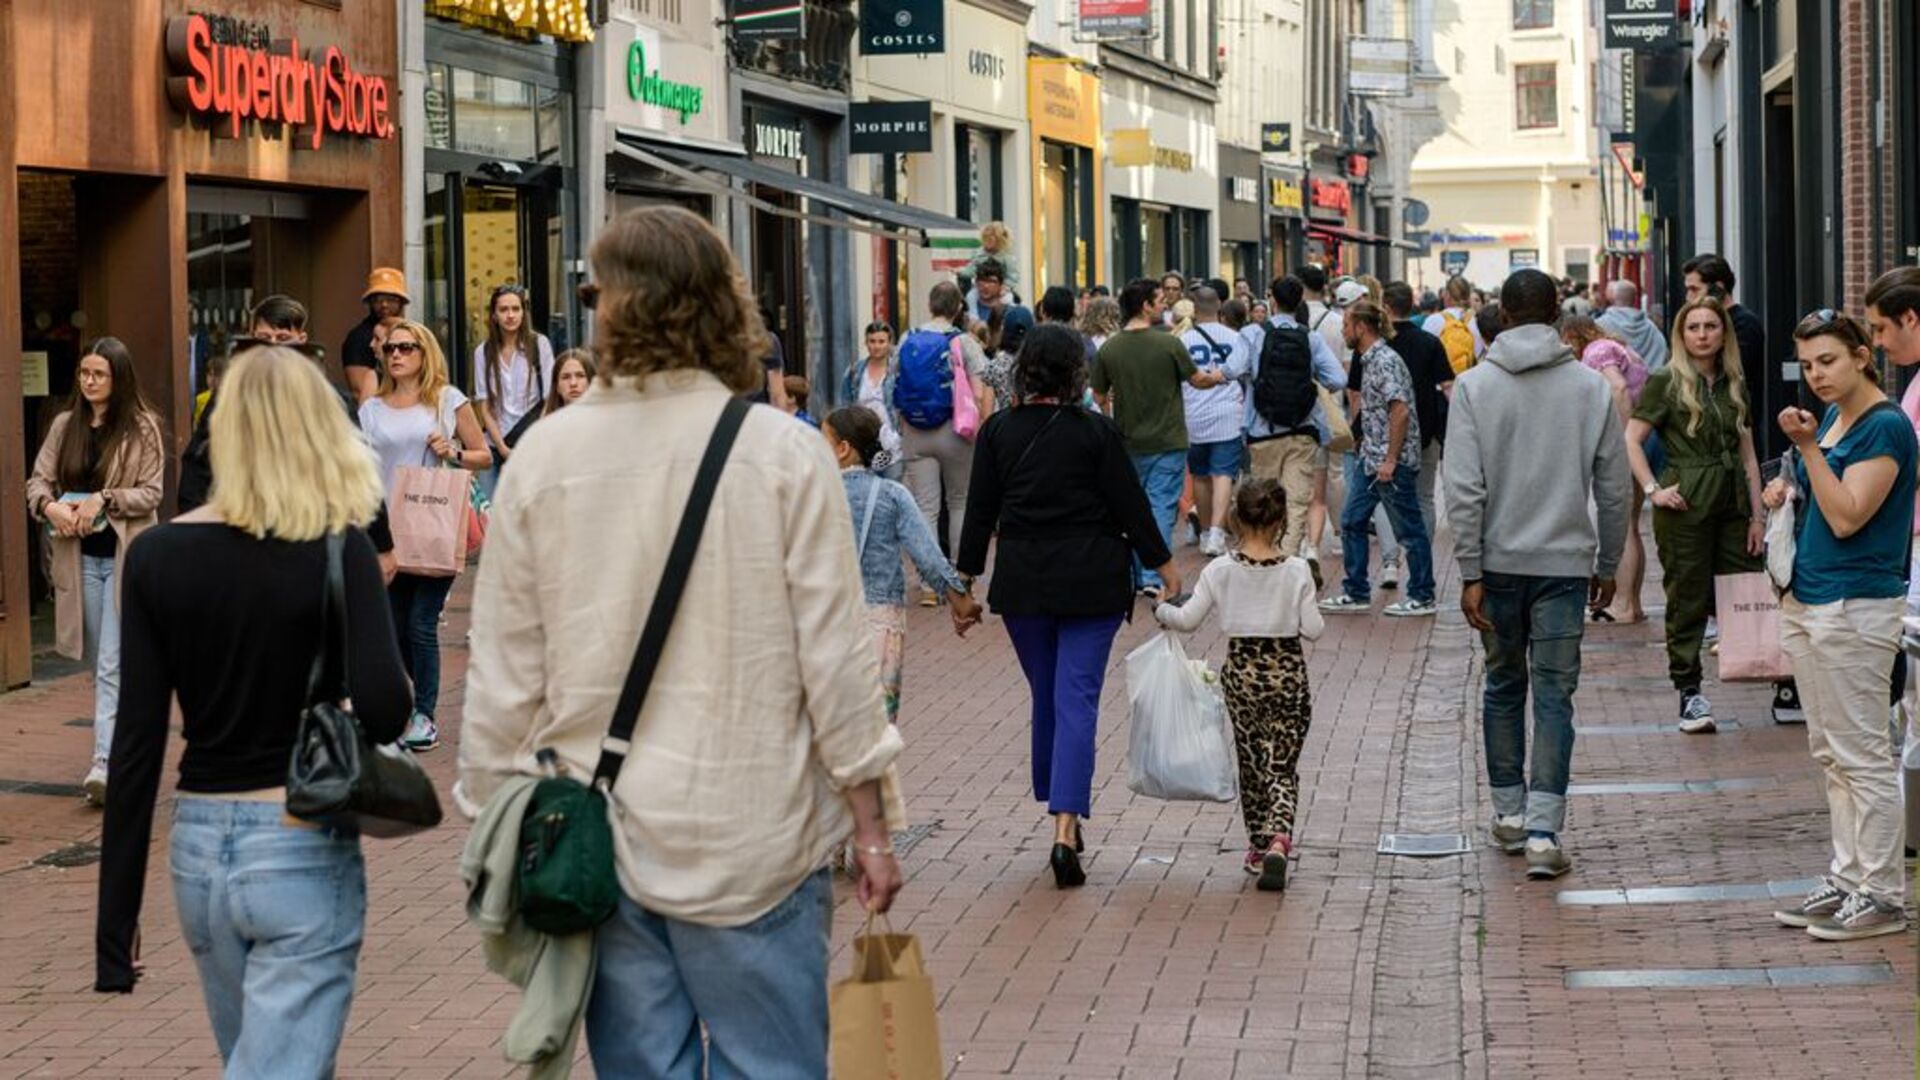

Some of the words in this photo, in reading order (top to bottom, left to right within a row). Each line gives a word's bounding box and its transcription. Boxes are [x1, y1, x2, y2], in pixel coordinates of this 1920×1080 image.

[1611, 23, 1670, 42] Wrangler
[871, 34, 936, 46] COSTES
[854, 120, 928, 134] MORPHE
[755, 123, 803, 160] MORPHE
[1733, 603, 1751, 613] THE
